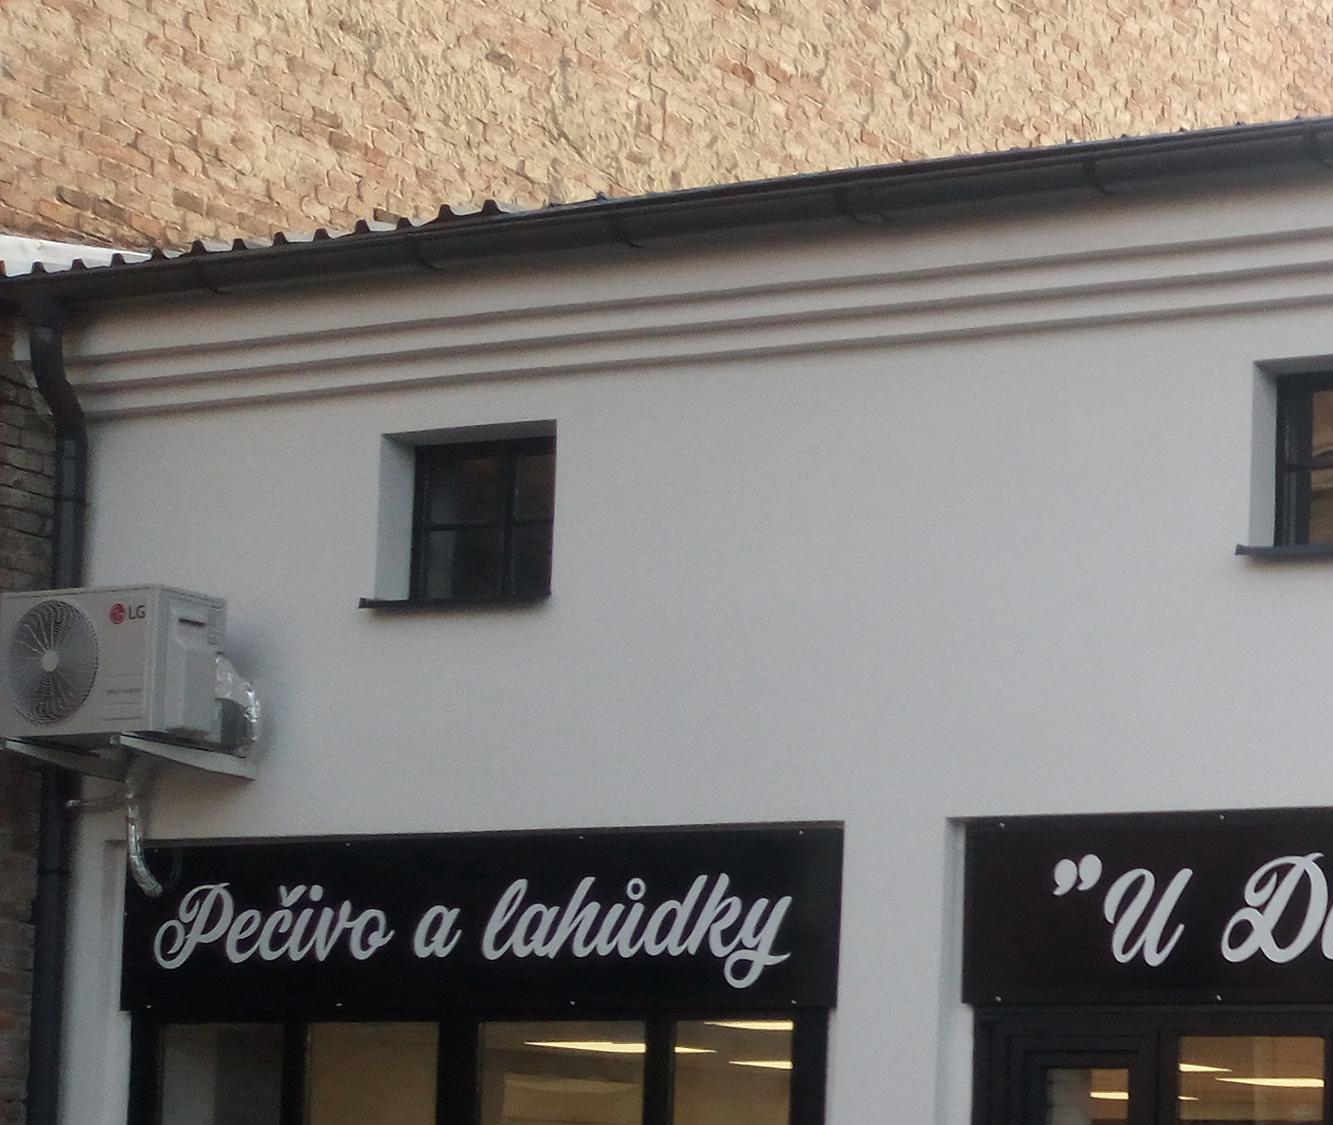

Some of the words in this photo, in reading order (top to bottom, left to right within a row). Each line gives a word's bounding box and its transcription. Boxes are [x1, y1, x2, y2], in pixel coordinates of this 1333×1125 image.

[128, 605, 147, 620] LG
[153, 881, 394, 970] Pečivo
[412, 903, 463, 959] a
[480, 872, 793, 989] lahůdky
